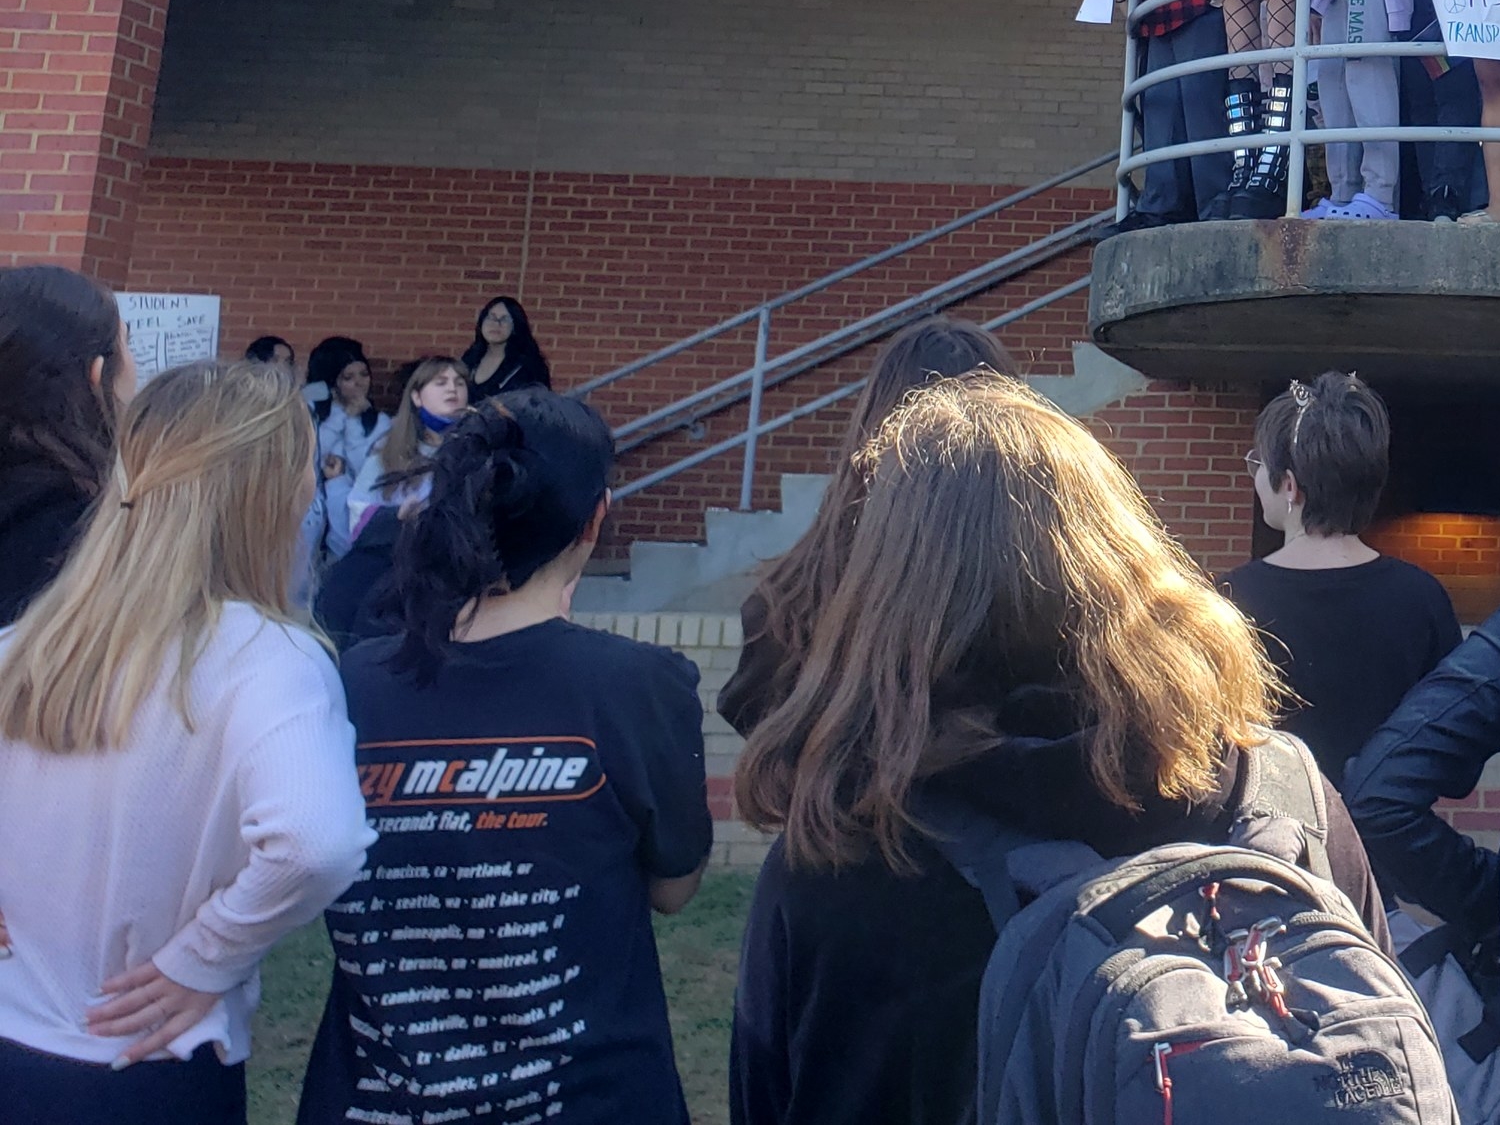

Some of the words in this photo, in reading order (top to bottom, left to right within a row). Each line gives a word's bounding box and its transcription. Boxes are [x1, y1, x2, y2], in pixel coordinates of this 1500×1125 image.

[403, 747, 588, 800] mcalpine
[376, 812, 438, 833] seconds
[439, 811, 473, 832] flat,
[476, 812, 506, 829] the
[508, 813, 548, 829] tour.
[471, 894, 496, 909] salt
[499, 891, 528, 907] lake
